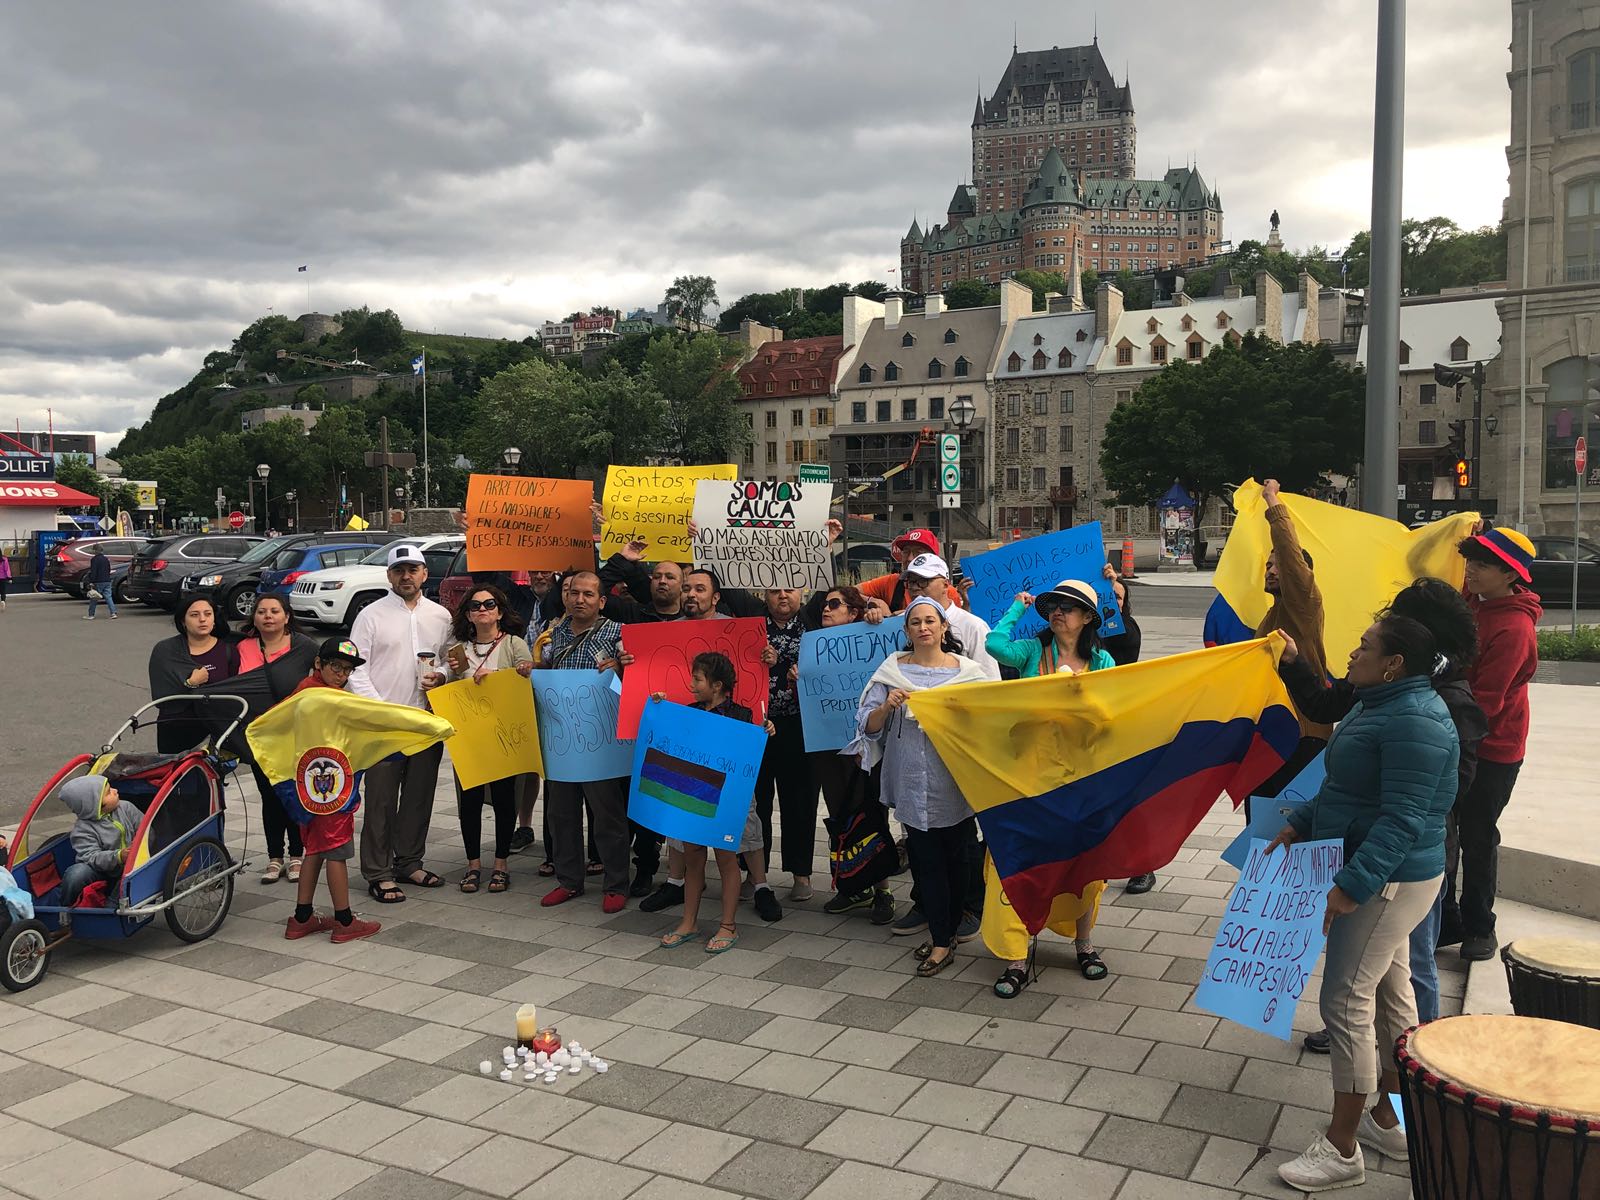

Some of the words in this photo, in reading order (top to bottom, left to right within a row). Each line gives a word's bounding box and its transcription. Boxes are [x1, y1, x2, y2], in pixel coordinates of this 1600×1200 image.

[613, 469, 684, 490] Santos,
[610, 491, 633, 503] de
[637, 494, 673, 508] paz,
[730, 481, 803, 501] SOMOS
[479, 500, 498, 514] LES
[501, 502, 561, 519] MASSACRES
[610, 505, 629, 521] los
[632, 509, 692, 526] asesinat
[726, 499, 796, 519] CAUCA
[476, 518, 492, 528] EN
[472, 533, 512, 549] CESSEZ
[657, 535, 692, 553] carg
[693, 527, 714, 545] NO
[715, 528, 749, 546] MAS
[751, 529, 829, 548] ASESINATOS
[694, 545, 713, 561] DE
[715, 546, 765, 562] LIDERES
[765, 546, 826, 564] SOCIALES
[1003, 551, 1046, 575] VIDA
[1052, 546, 1071, 565] ES
[1075, 541, 1095, 556] UN
[727, 560, 832, 590] COLOMBIA
[815, 629, 908, 666] PROTEJAMO
[802, 674, 835, 697] LOS
[1243, 847, 1272, 885] NO
[1229, 886, 1259, 914] DE
[1216, 921, 1300, 960] SOCIALES
[1211, 957, 1309, 1000] CAMPESINOS
